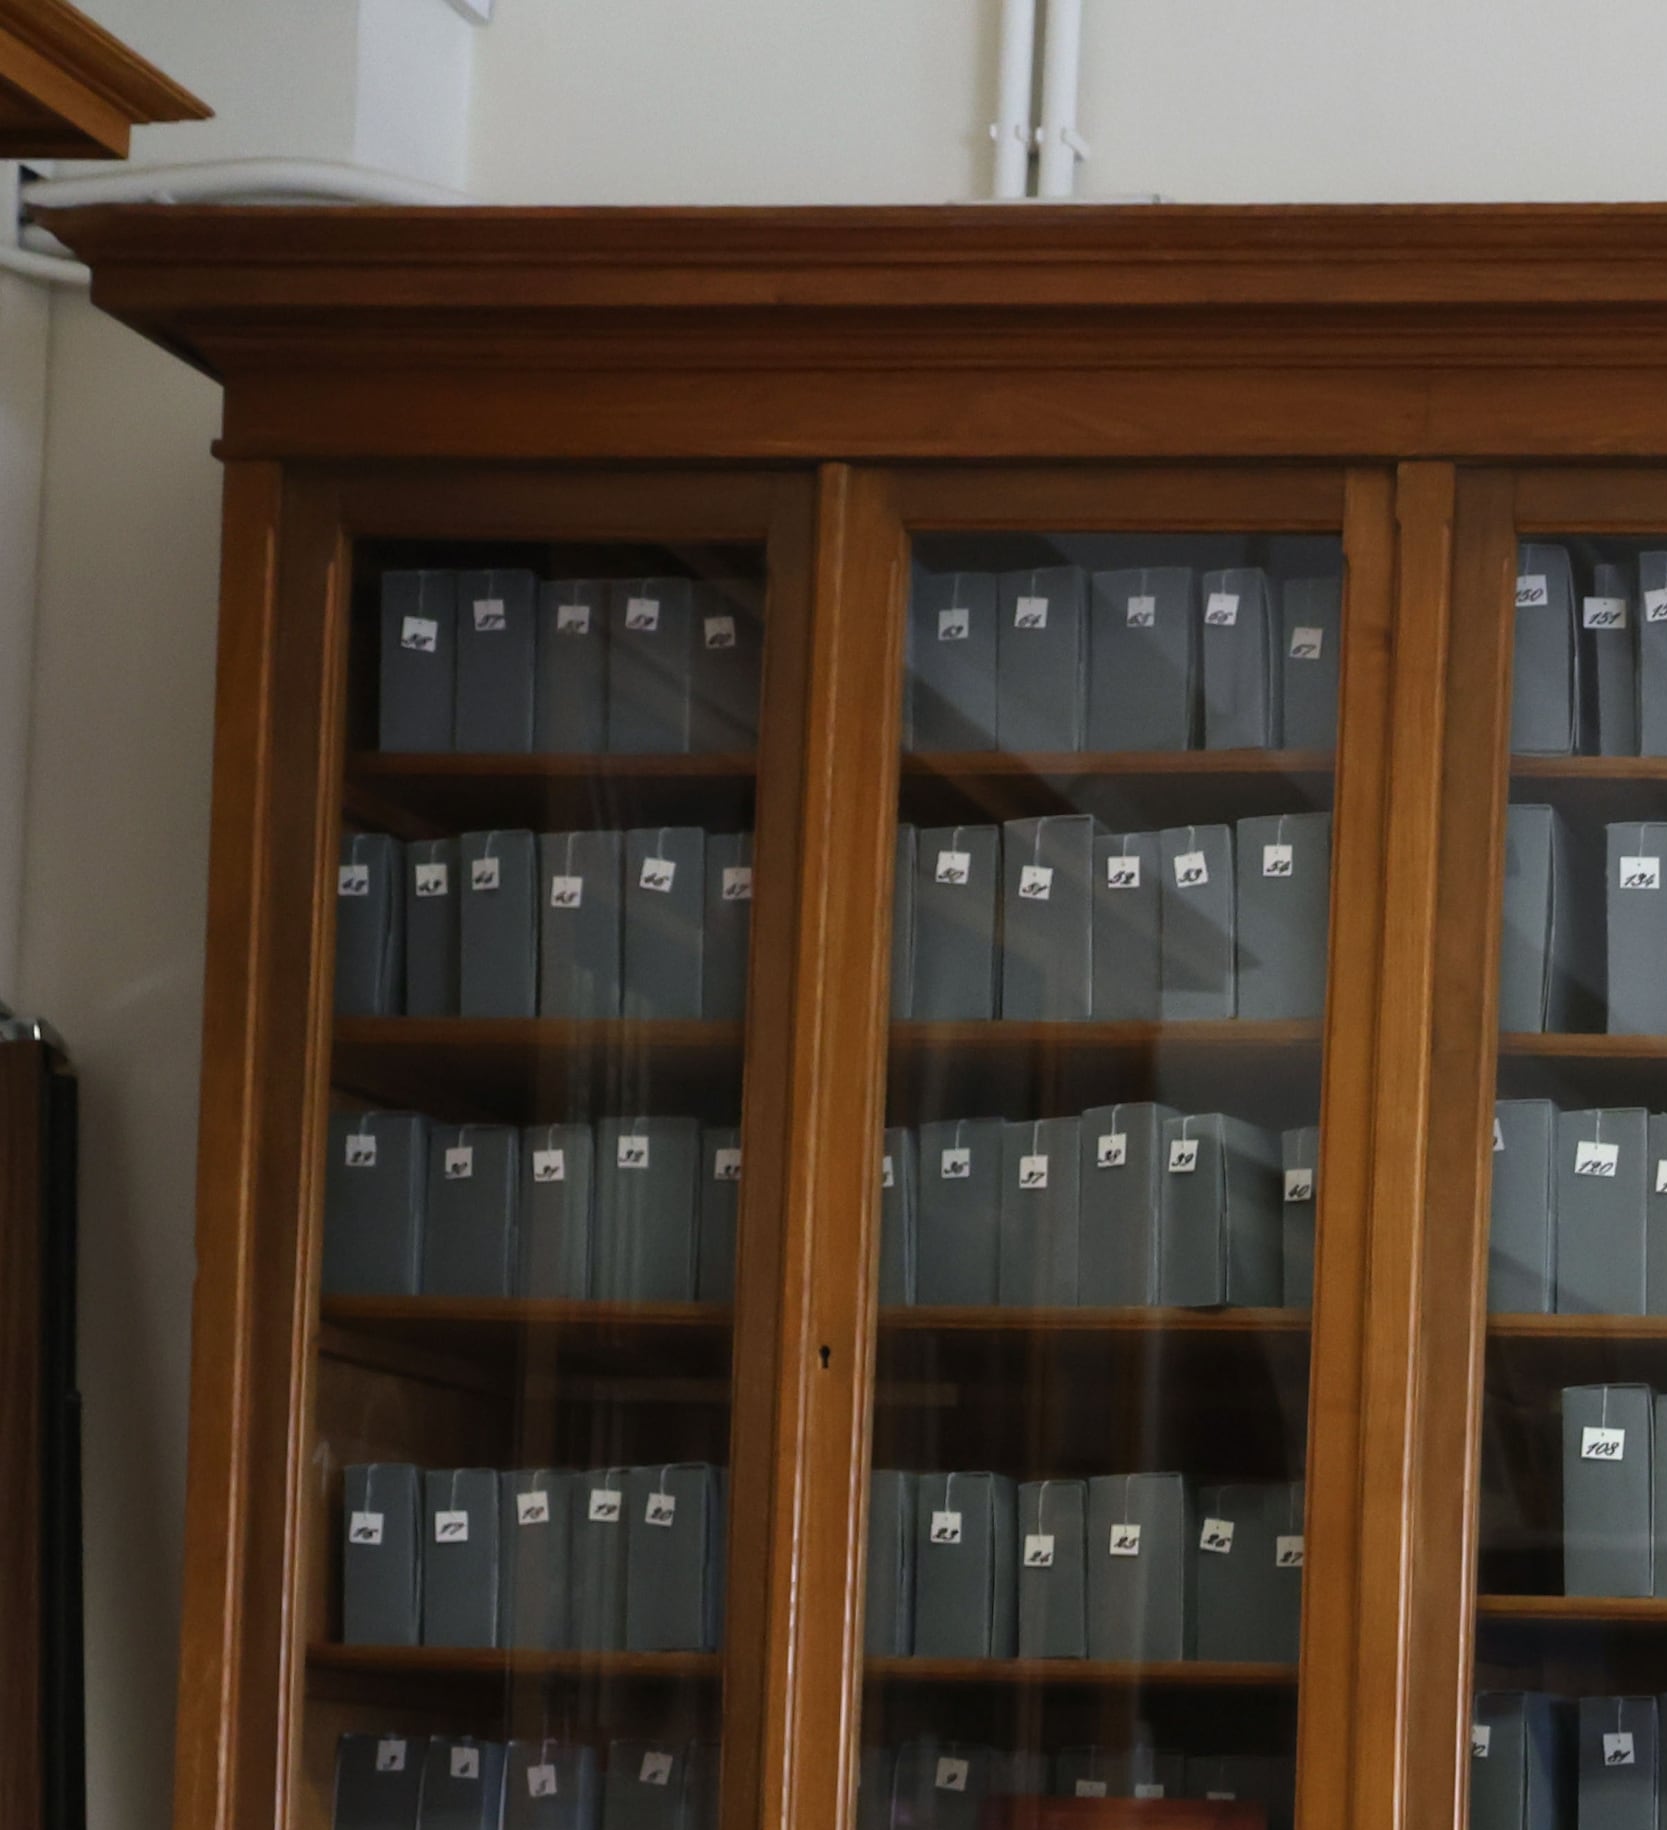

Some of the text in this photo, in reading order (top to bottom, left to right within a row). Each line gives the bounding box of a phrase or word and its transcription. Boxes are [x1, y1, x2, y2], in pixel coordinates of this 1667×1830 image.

[478, 613, 505, 628] 57
[1018, 614, 1042, 627] 64
[1588, 609, 1624, 625] 151
[1290, 643, 1317, 656] 67
[1178, 867, 1202, 882] 53
[1265, 860, 1291, 874] 54
[1108, 870, 1135, 885] 52
[1623, 872, 1656, 888] 134
[1022, 882, 1048, 896] 51
[1171, 1152, 1195, 1167] 39
[1578, 1159, 1614, 1175] 120
[944, 1160, 970, 1175] 36
[1022, 1170, 1045, 1185] 37
[1585, 1441, 1620, 1457] 108
[933, 1527, 960, 1543] 23
[1204, 1533, 1232, 1548] 26
[1114, 1536, 1140, 1550] 25
[1279, 1550, 1303, 1565] 27
